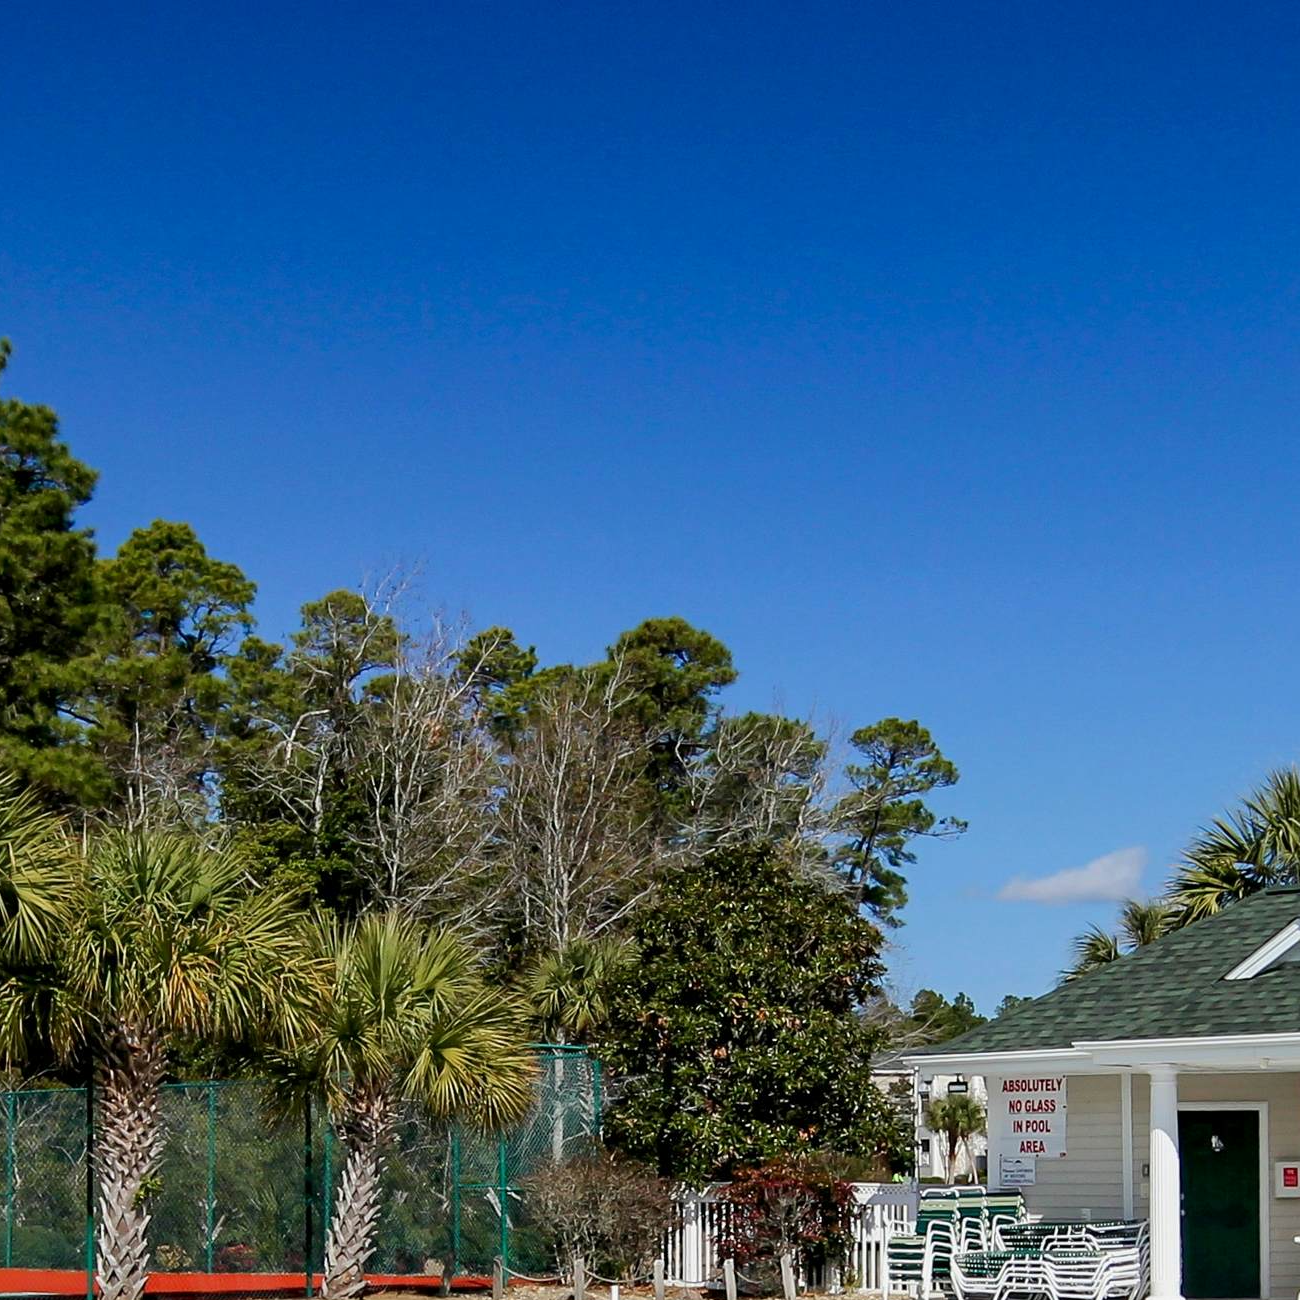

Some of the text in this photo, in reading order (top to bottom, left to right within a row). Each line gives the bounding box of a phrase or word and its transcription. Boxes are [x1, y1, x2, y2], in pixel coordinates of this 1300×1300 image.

[1002, 1079, 1063, 1092] ABSOLUTELY
[1009, 1099, 1056, 1112] NO GLASS
[1013, 1120, 1051, 1133] IN POOL
[1020, 1141, 1046, 1153] AREA
